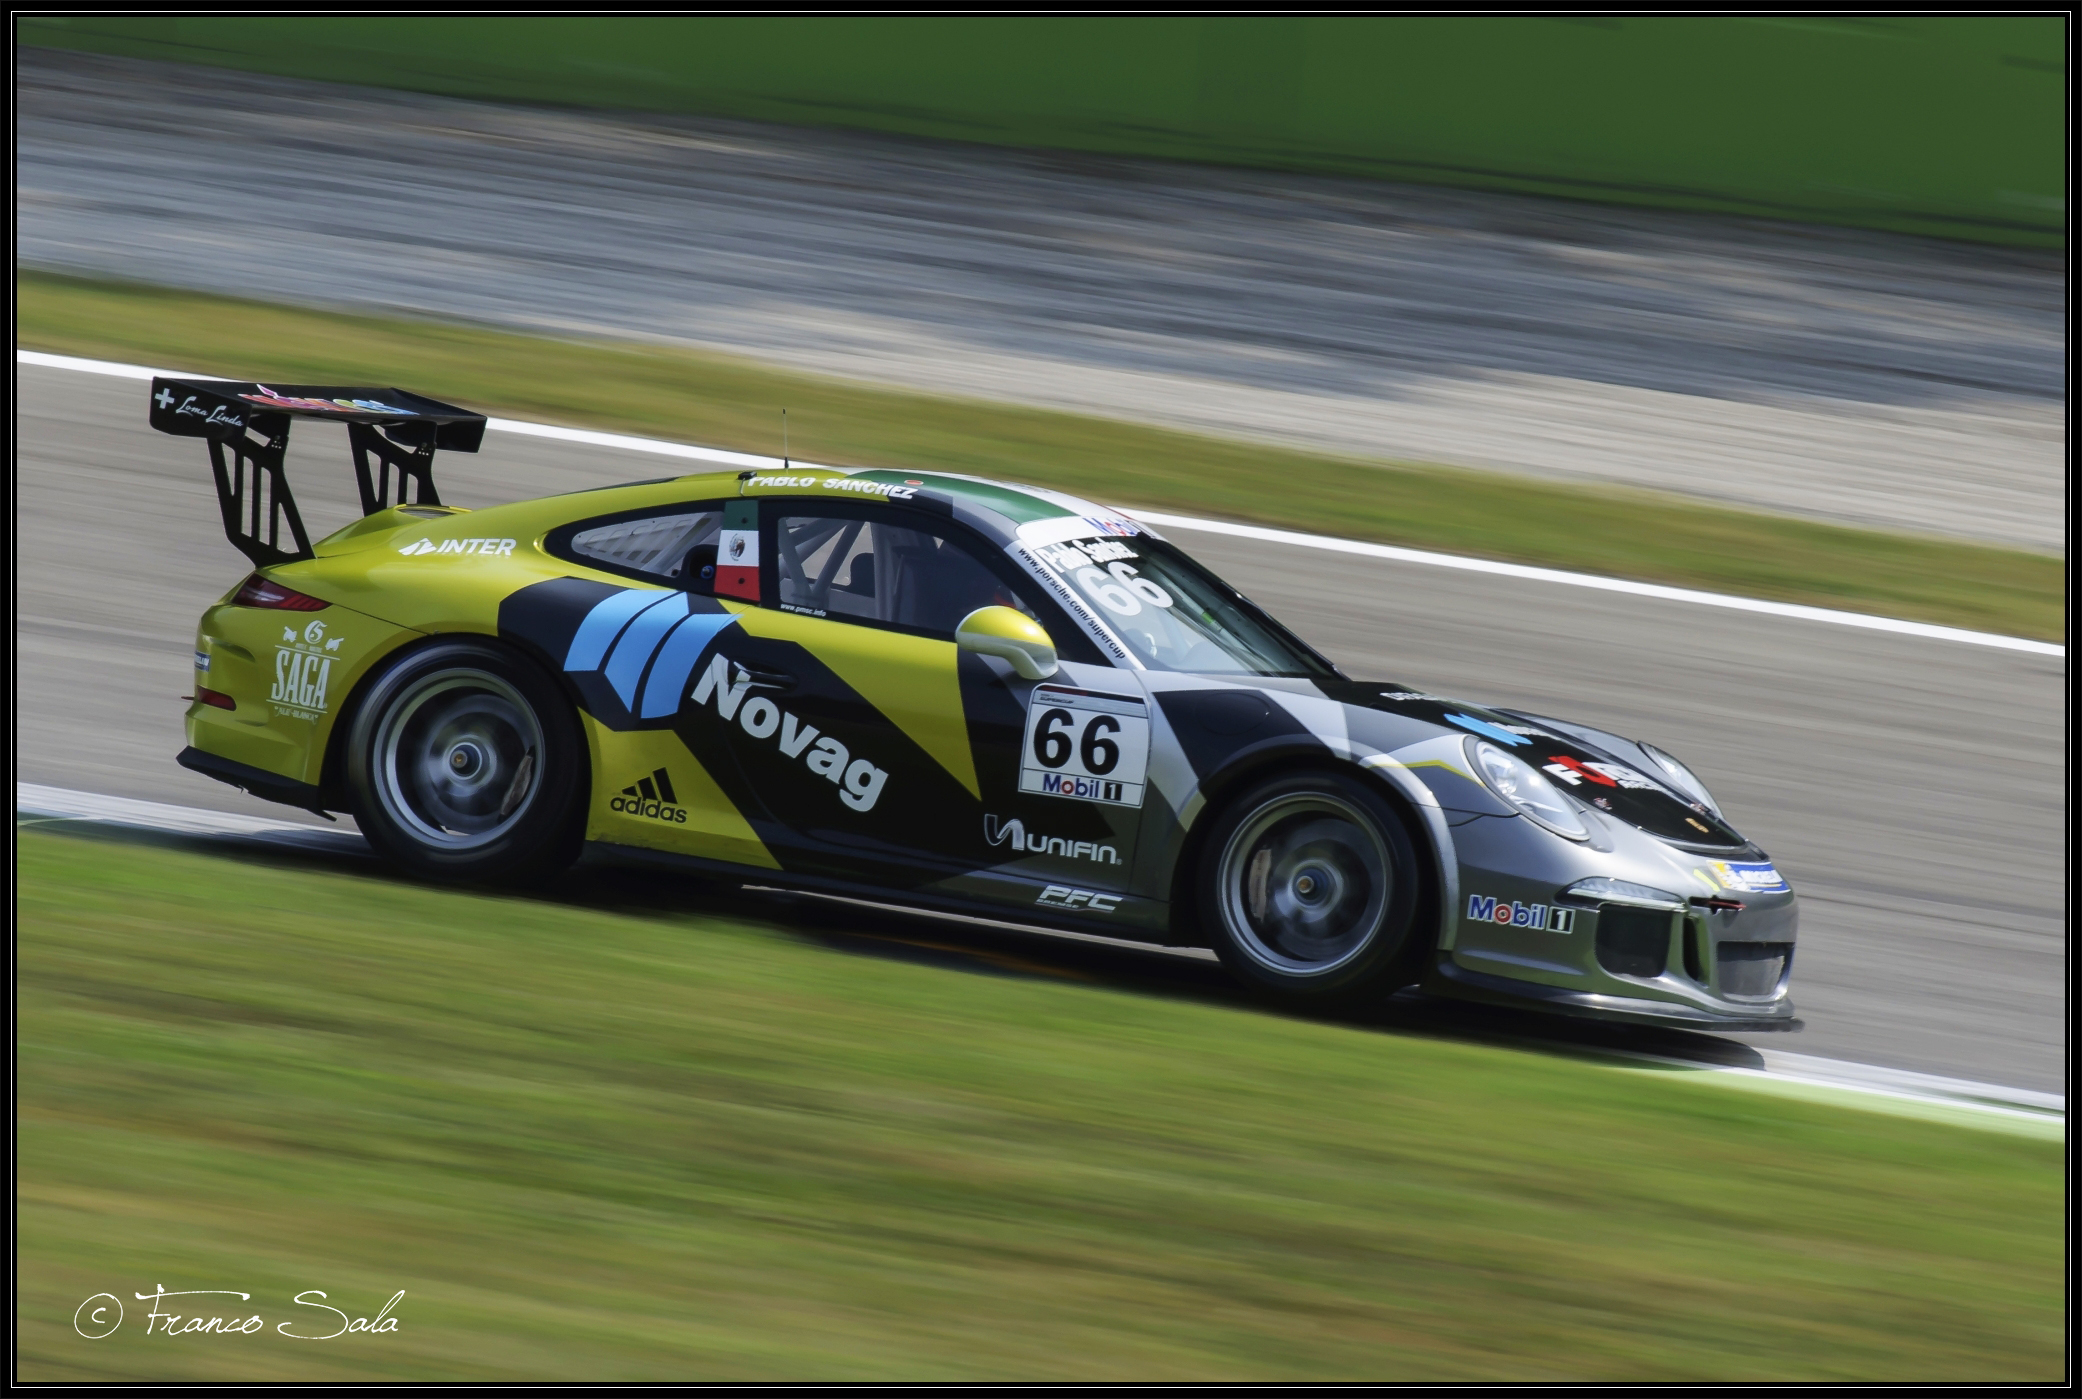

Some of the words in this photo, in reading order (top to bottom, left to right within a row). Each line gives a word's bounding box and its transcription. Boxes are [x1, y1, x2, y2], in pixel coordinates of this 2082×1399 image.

[175, 396, 208, 416] Loma
[206, 406, 244, 427] Linda
[748, 476, 816, 487] PABLO
[822, 478, 918, 500] SANCHEZ
[437, 538, 517, 556] INTER
[1034, 543, 1093, 573] Pablo
[1017, 547, 1126, 660] www.porsche.com/supercup
[1076, 561, 1174, 616] 66
[271, 649, 330, 709] SAGA
[691, 652, 889, 812] Novag
[1033, 708, 1121, 776] 66
[1043, 773, 1099, 799] Mobil
[610, 796, 688, 824] adidas
[1039, 885, 1124, 911] PFC
[1467, 894, 1547, 930] Mobil
